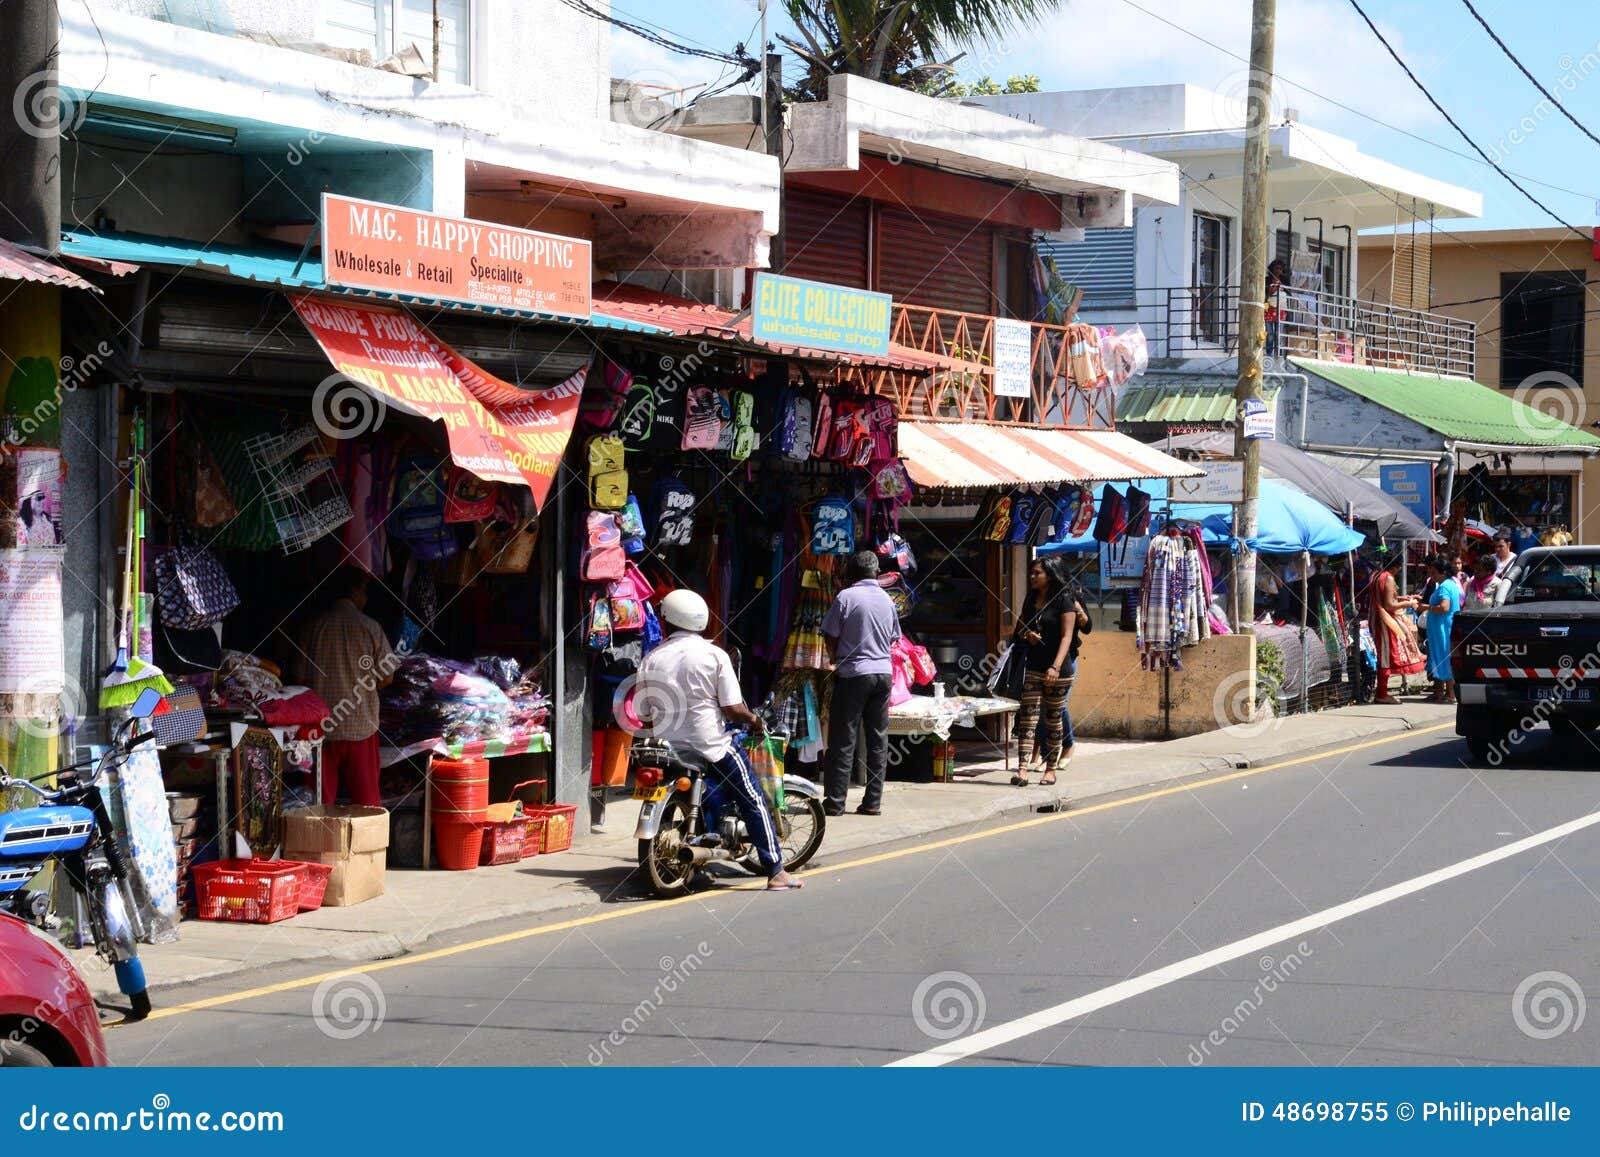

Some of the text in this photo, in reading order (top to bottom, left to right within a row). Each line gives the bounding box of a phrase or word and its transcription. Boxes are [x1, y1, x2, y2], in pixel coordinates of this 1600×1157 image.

[349, 205, 573, 268] MAG. HAPPY SHOPPING
[334, 249, 402, 275] Wholesale
[405, 259, 413, 278] &
[417, 263, 453, 285] Retail
[760, 279, 888, 333] ELITE COLLECTION
[762, 320, 883, 349] wholesale shop
[501, 404, 559, 427] Articles
[656, 414, 675, 425] NIKE
[1466, 644, 1528, 656] ISUZU
